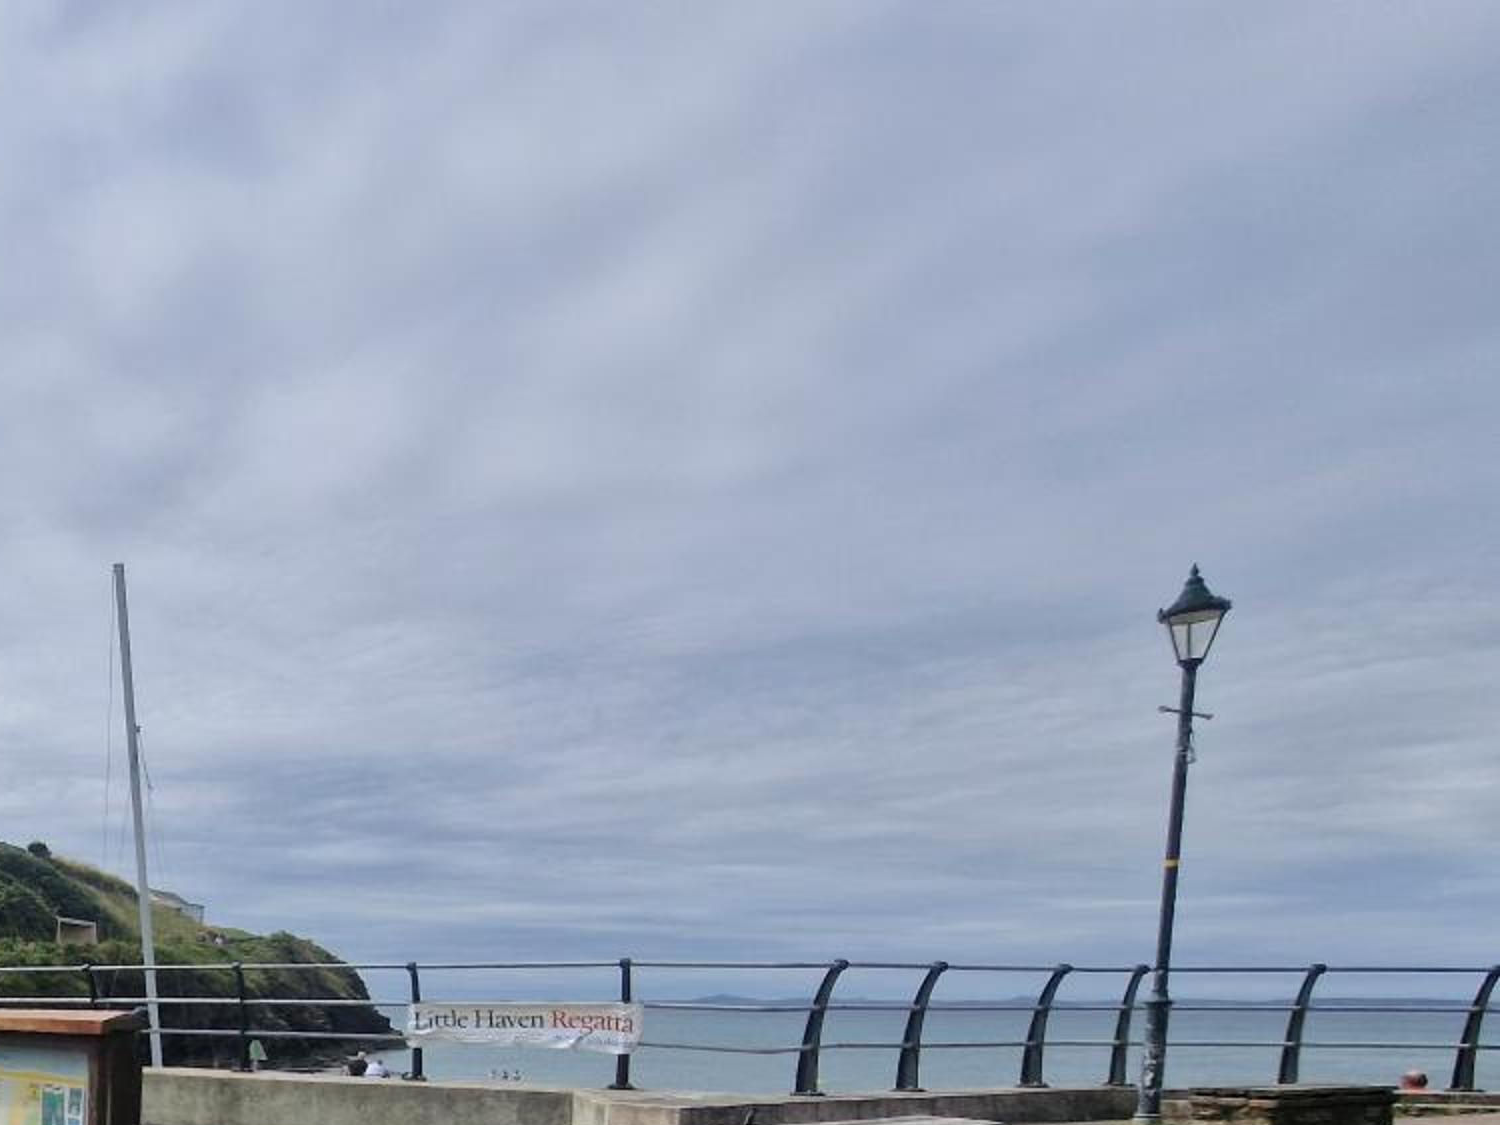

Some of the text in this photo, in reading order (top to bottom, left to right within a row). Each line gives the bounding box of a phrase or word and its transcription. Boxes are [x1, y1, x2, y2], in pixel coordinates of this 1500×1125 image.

[414, 1008, 633, 1034] Little Haven Regatta
